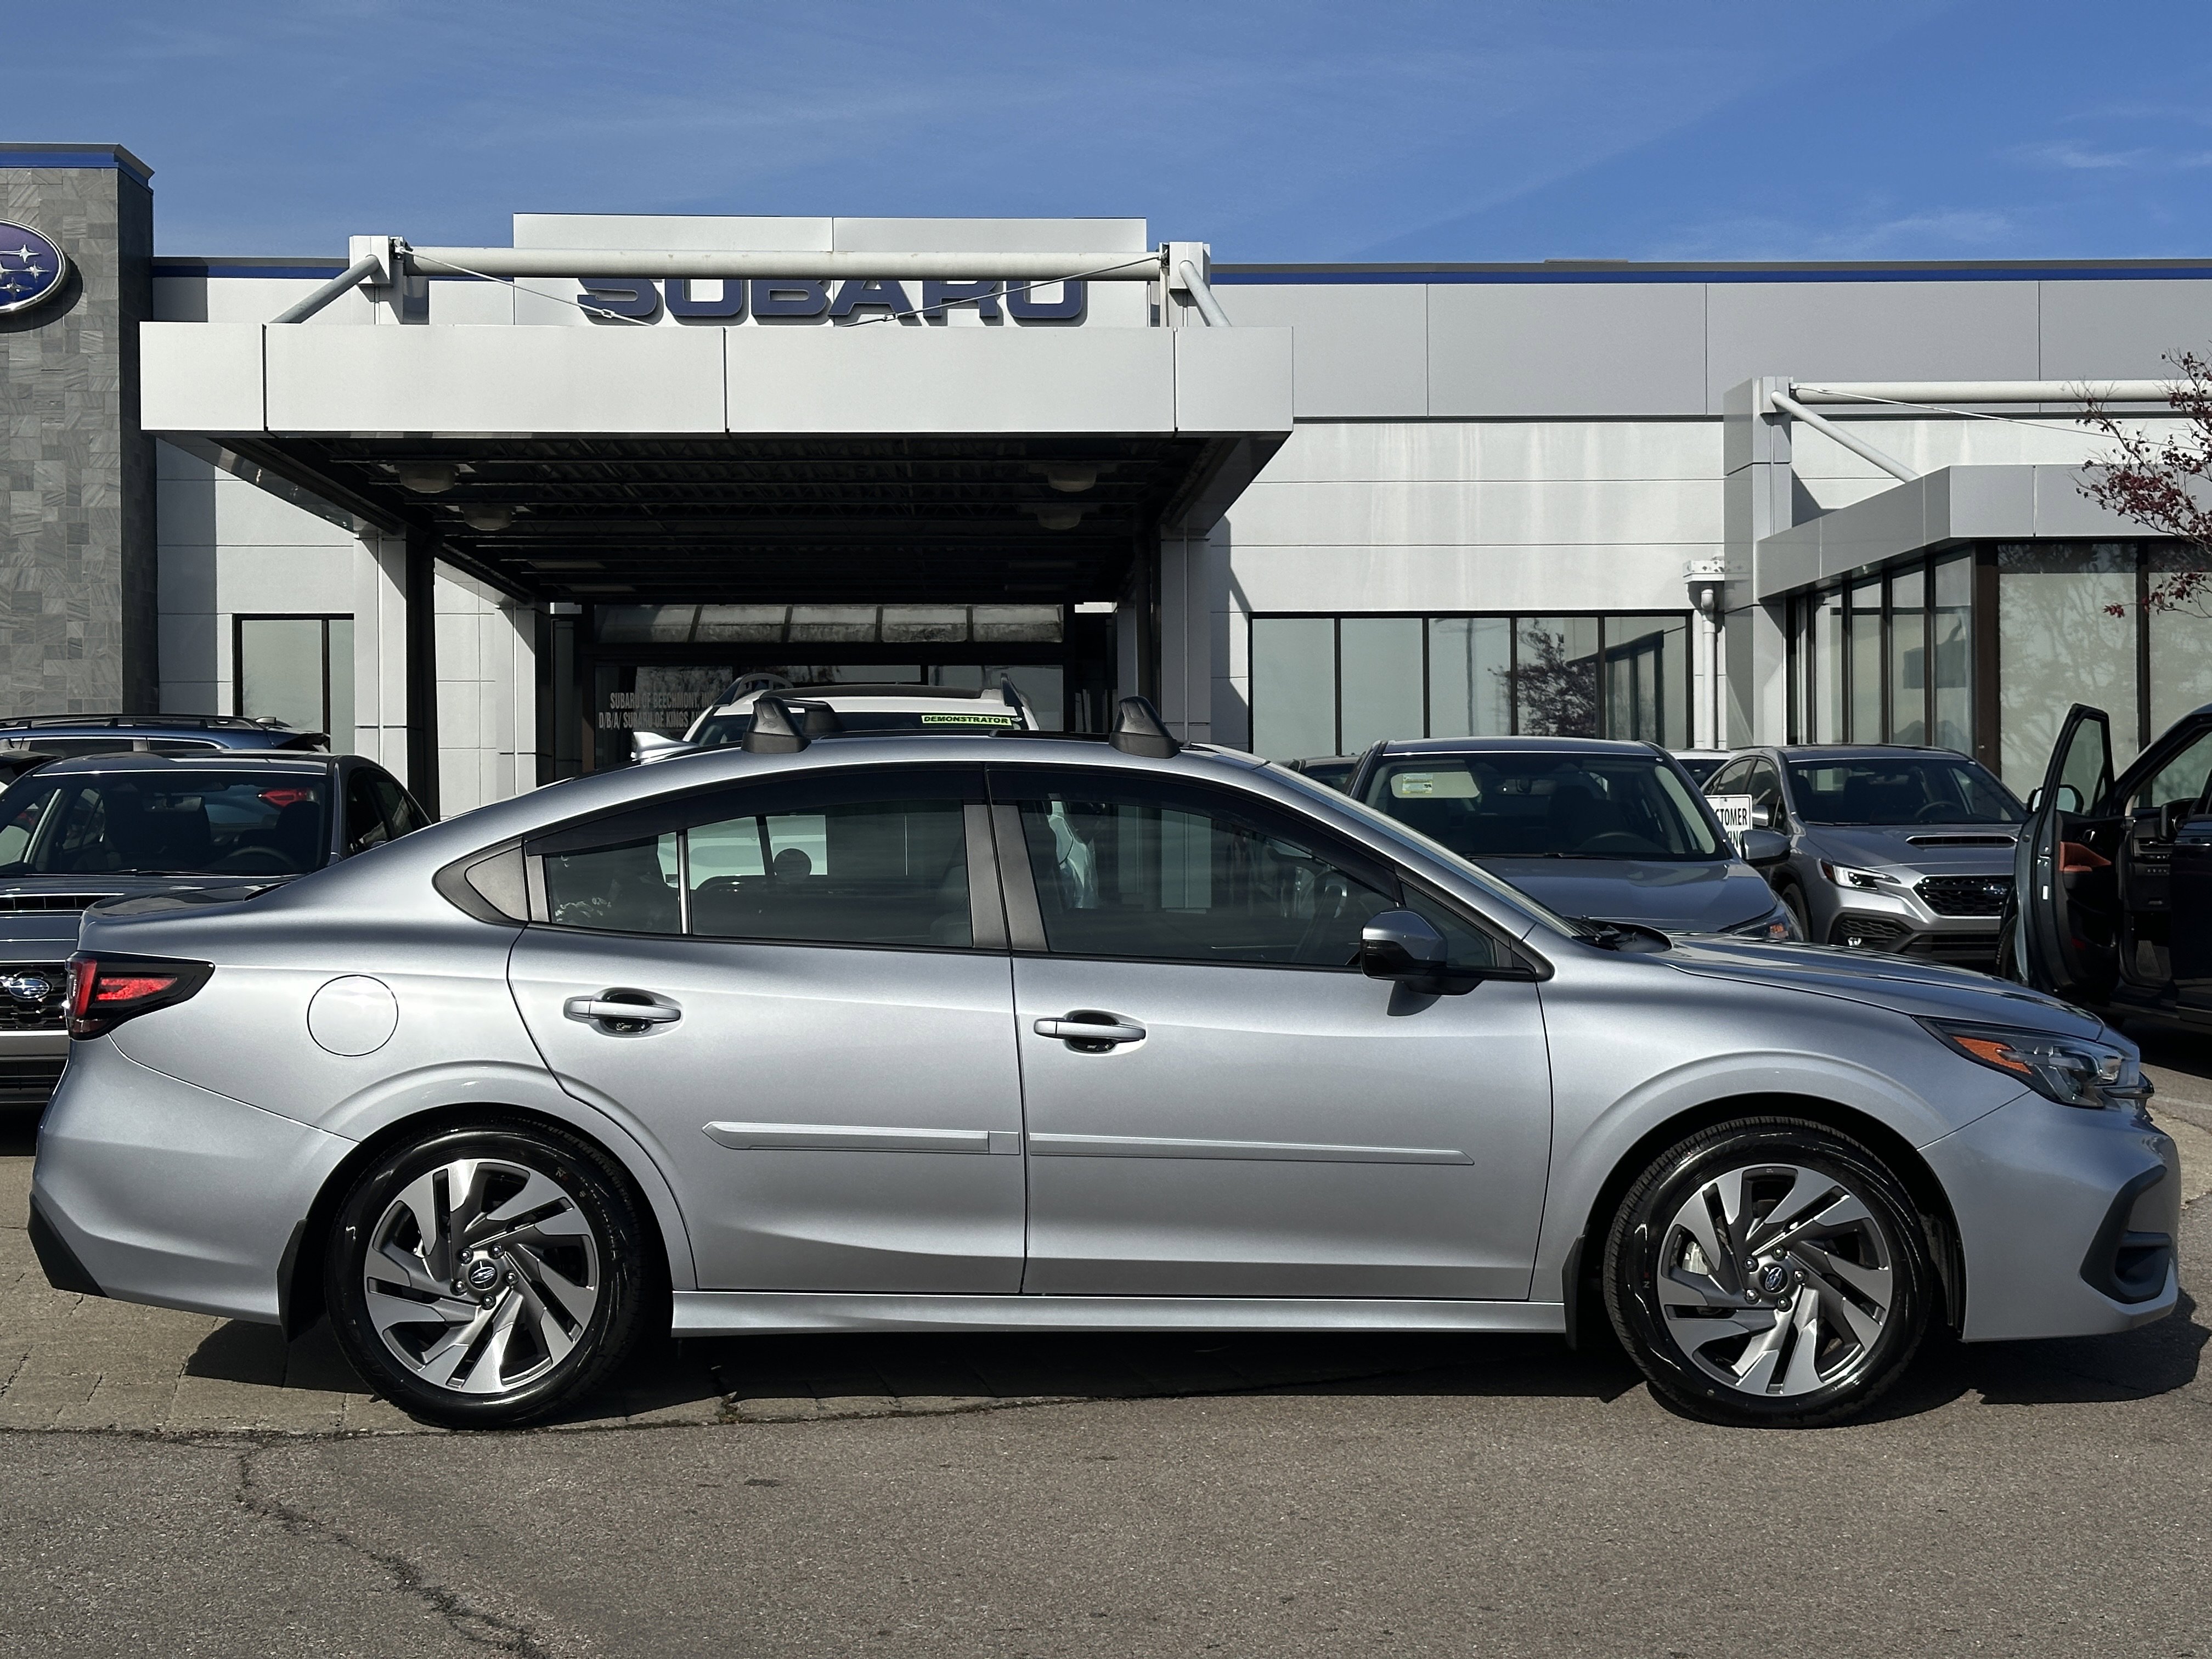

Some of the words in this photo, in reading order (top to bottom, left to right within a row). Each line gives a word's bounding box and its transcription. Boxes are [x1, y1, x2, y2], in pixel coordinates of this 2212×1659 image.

[577, 278, 1083, 319] SUBARU
[610, 692, 640, 709] SUBARU
[642, 692, 651, 709] OF
[623, 712, 653, 728] SUBARU
[665, 711, 689, 728] KINGS
[923, 716, 1009, 724] DEMONSTRATOR
